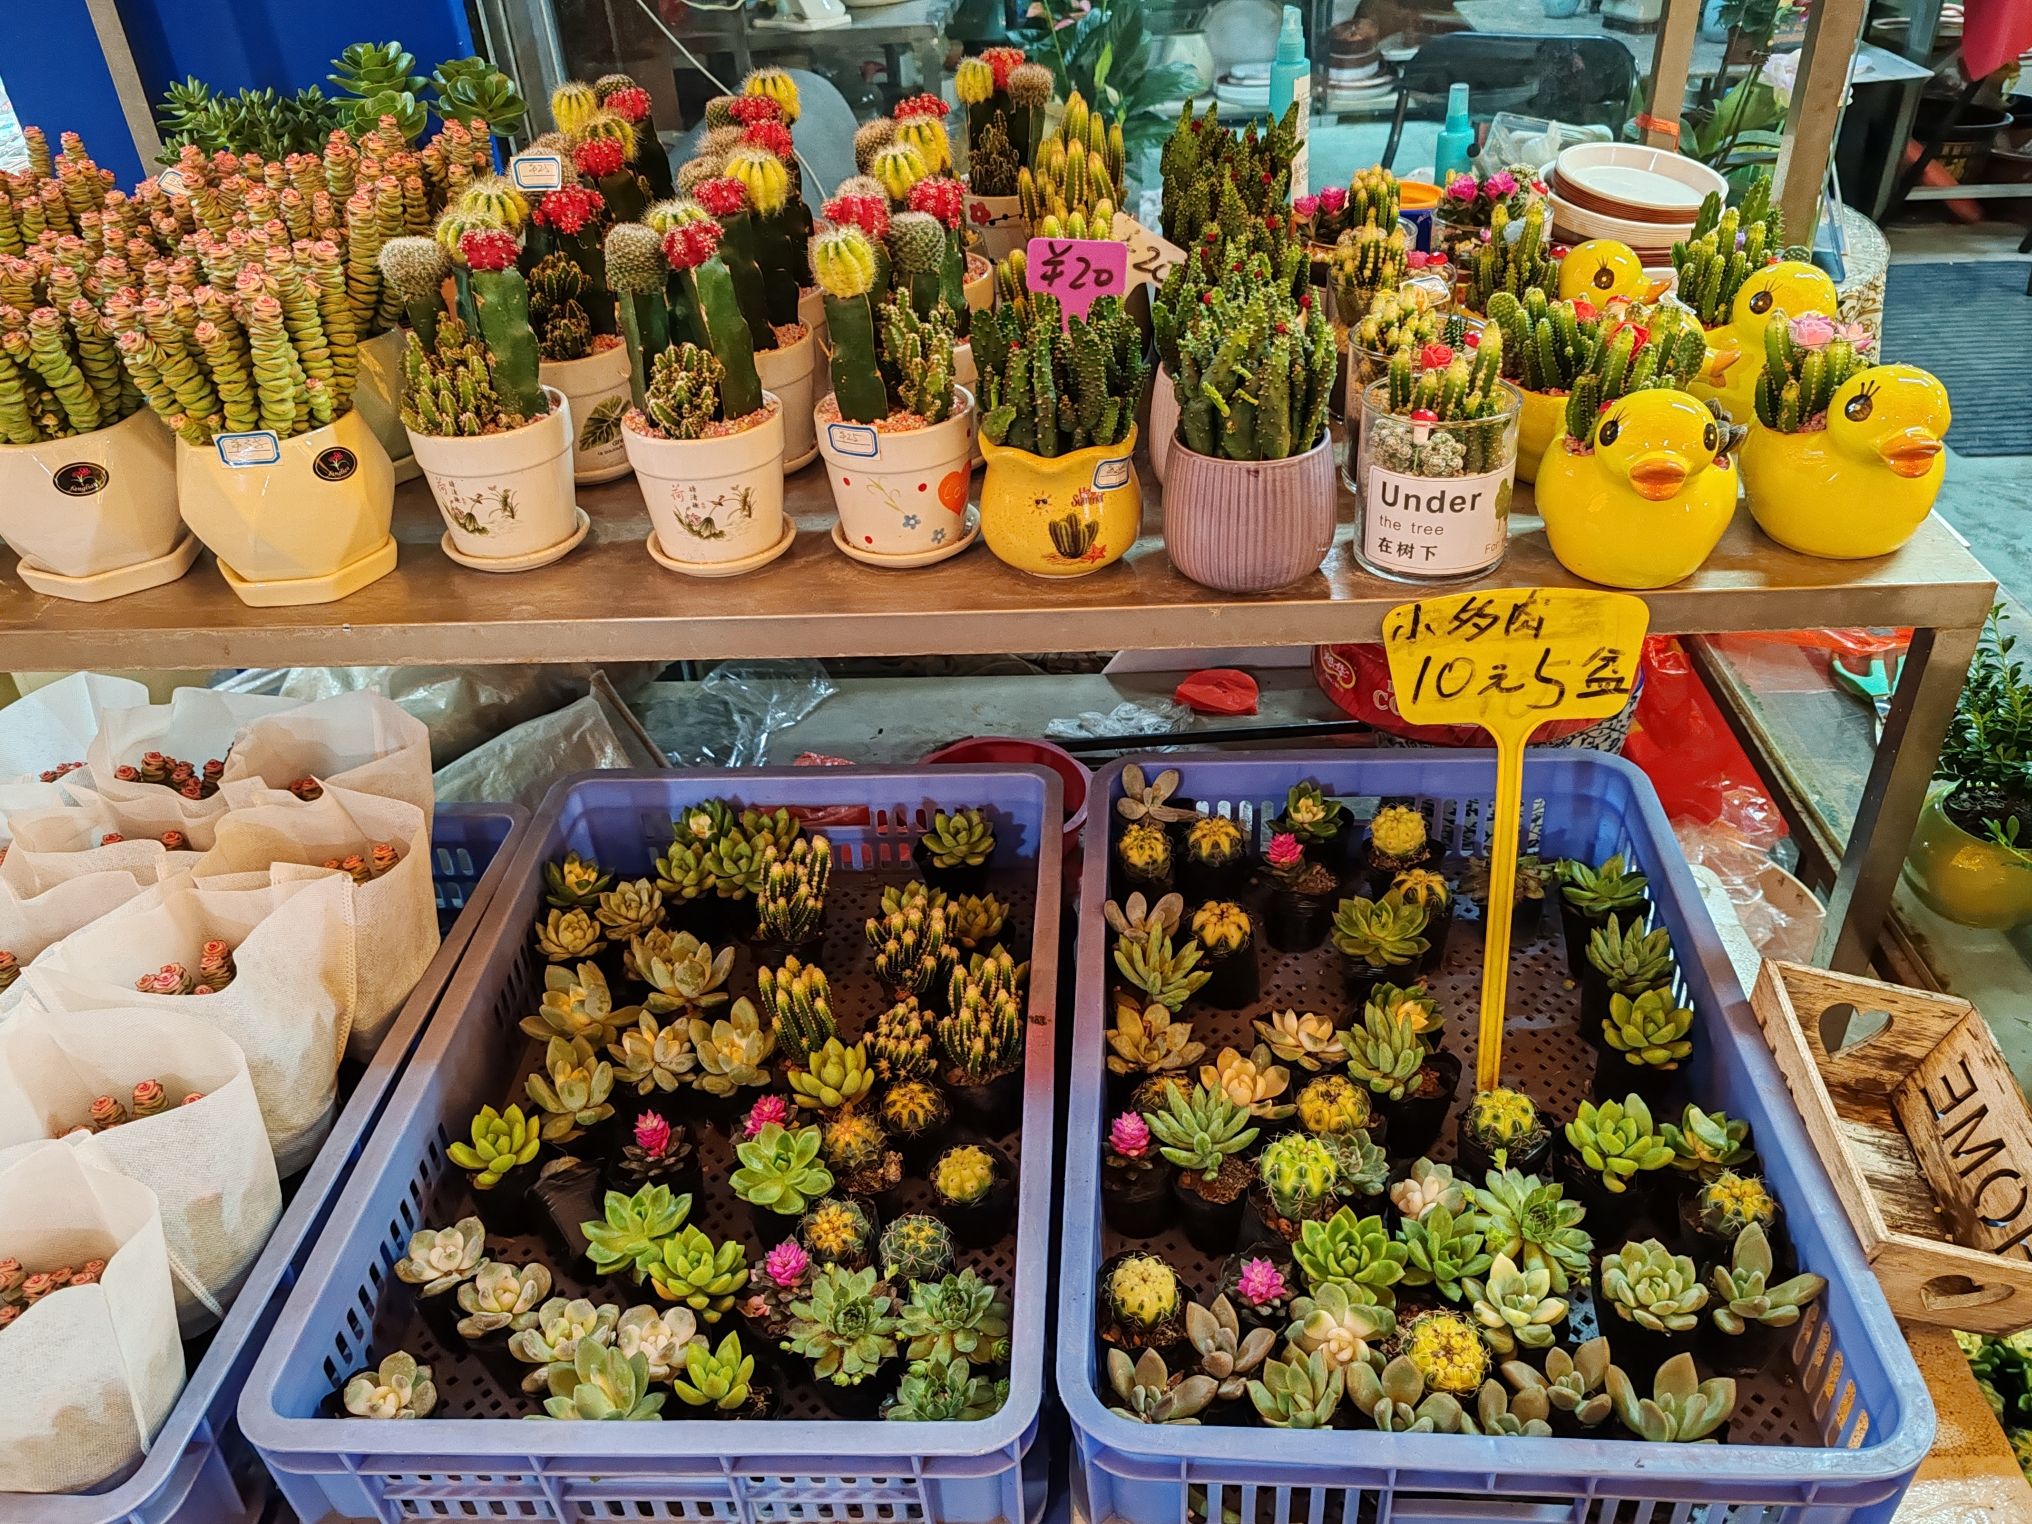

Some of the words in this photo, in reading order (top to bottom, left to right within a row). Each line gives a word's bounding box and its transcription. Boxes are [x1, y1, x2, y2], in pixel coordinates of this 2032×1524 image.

[1040, 241, 1114, 290] ¥20
[1381, 481, 1483, 514] Under
[1379, 514, 1402, 531] the
[1411, 522, 1445, 536] tree
[1378, 536, 1438, 561] 在树下
